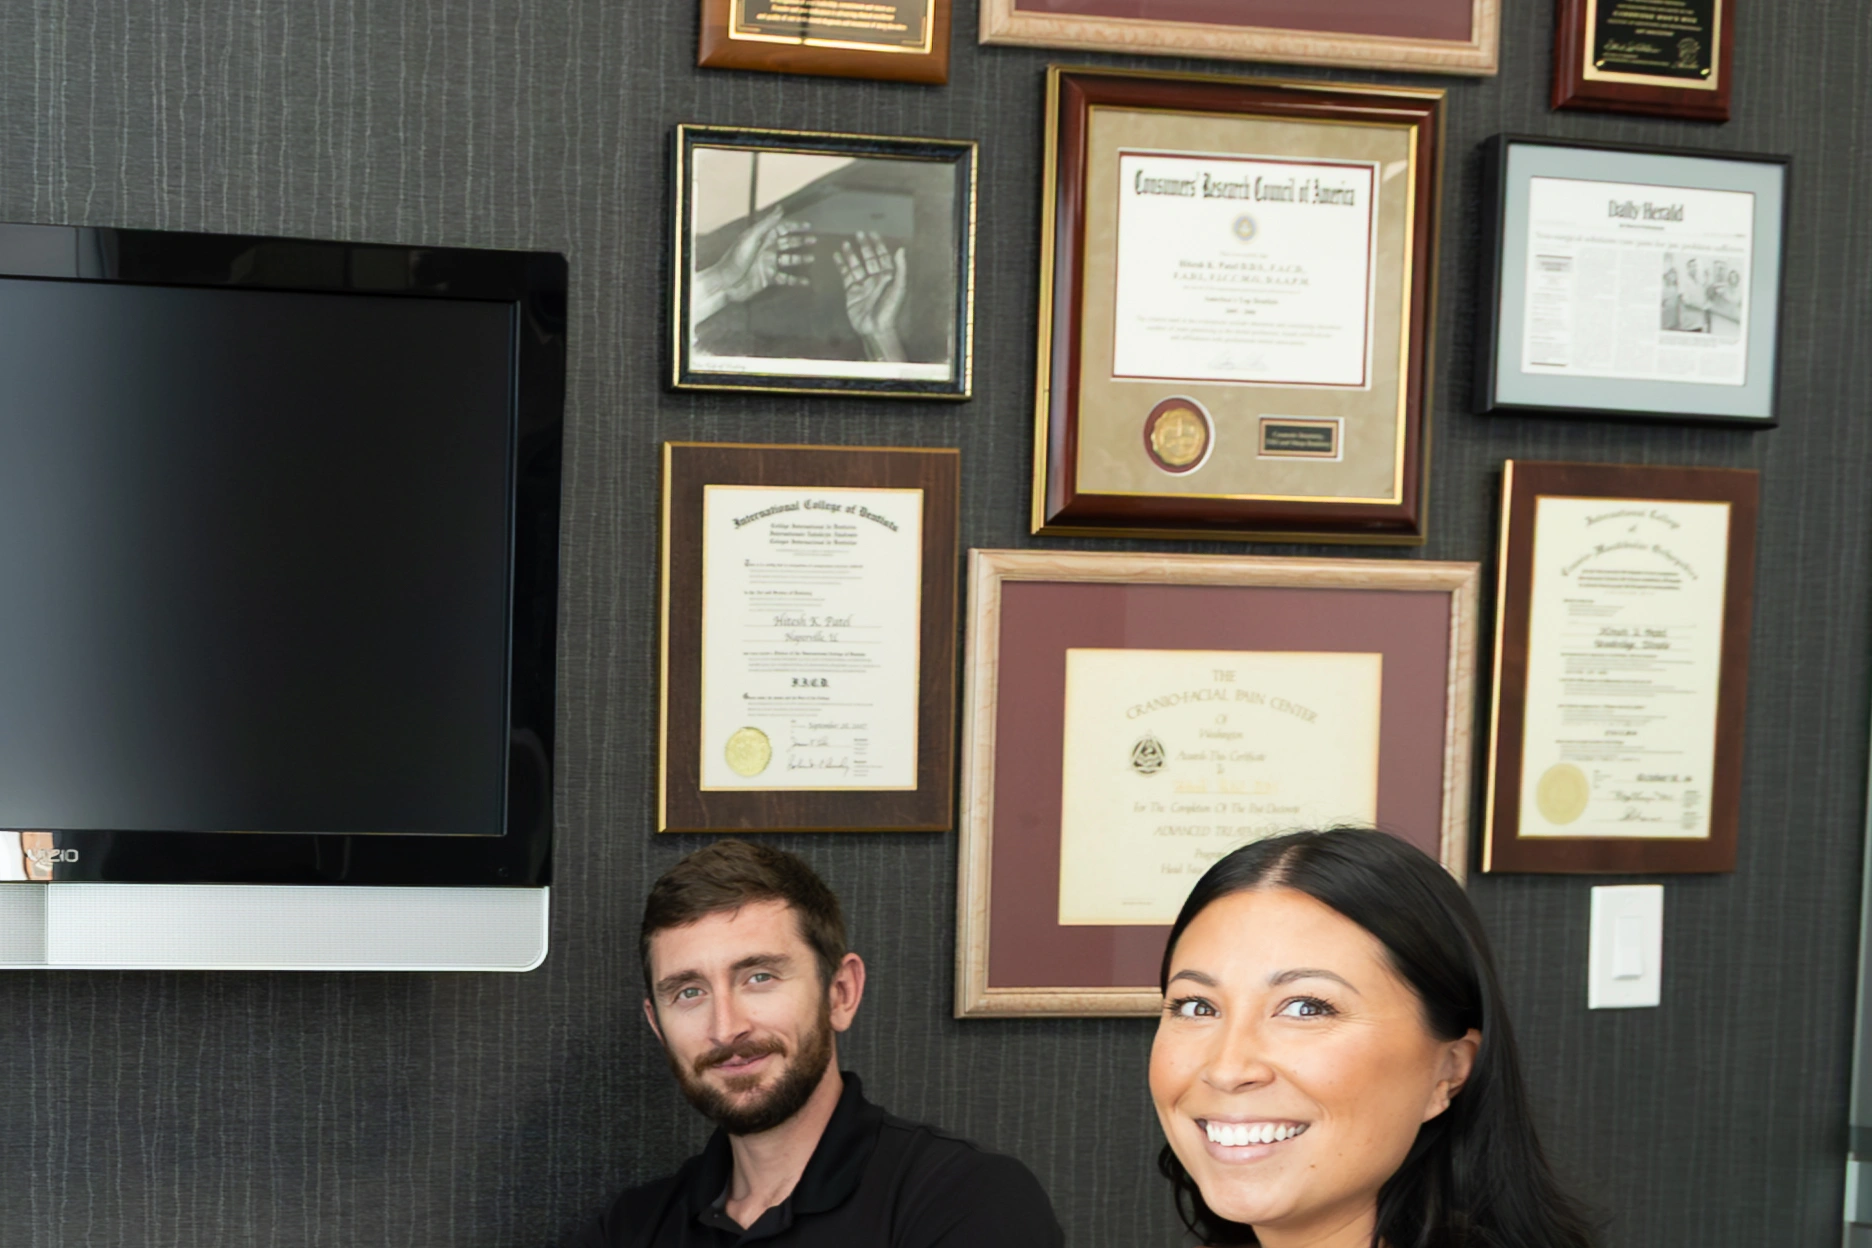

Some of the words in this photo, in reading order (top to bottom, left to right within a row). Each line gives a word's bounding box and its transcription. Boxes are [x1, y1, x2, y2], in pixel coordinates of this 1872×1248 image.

[1608, 199, 1639, 220] Daily
[1642, 201, 1684, 222] Herald
[732, 500, 800, 530] International
[803, 497, 842, 514] College
[845, 504, 858, 514] of
[859, 505, 899, 533] Dentists
[825, 613, 854, 628] Patel
[1212, 669, 1237, 682] THE
[1125, 688, 1229, 721] CRANIO-FACIAL
[1235, 688, 1266, 705] PAIN
[1270, 697, 1318, 724] CENTER
